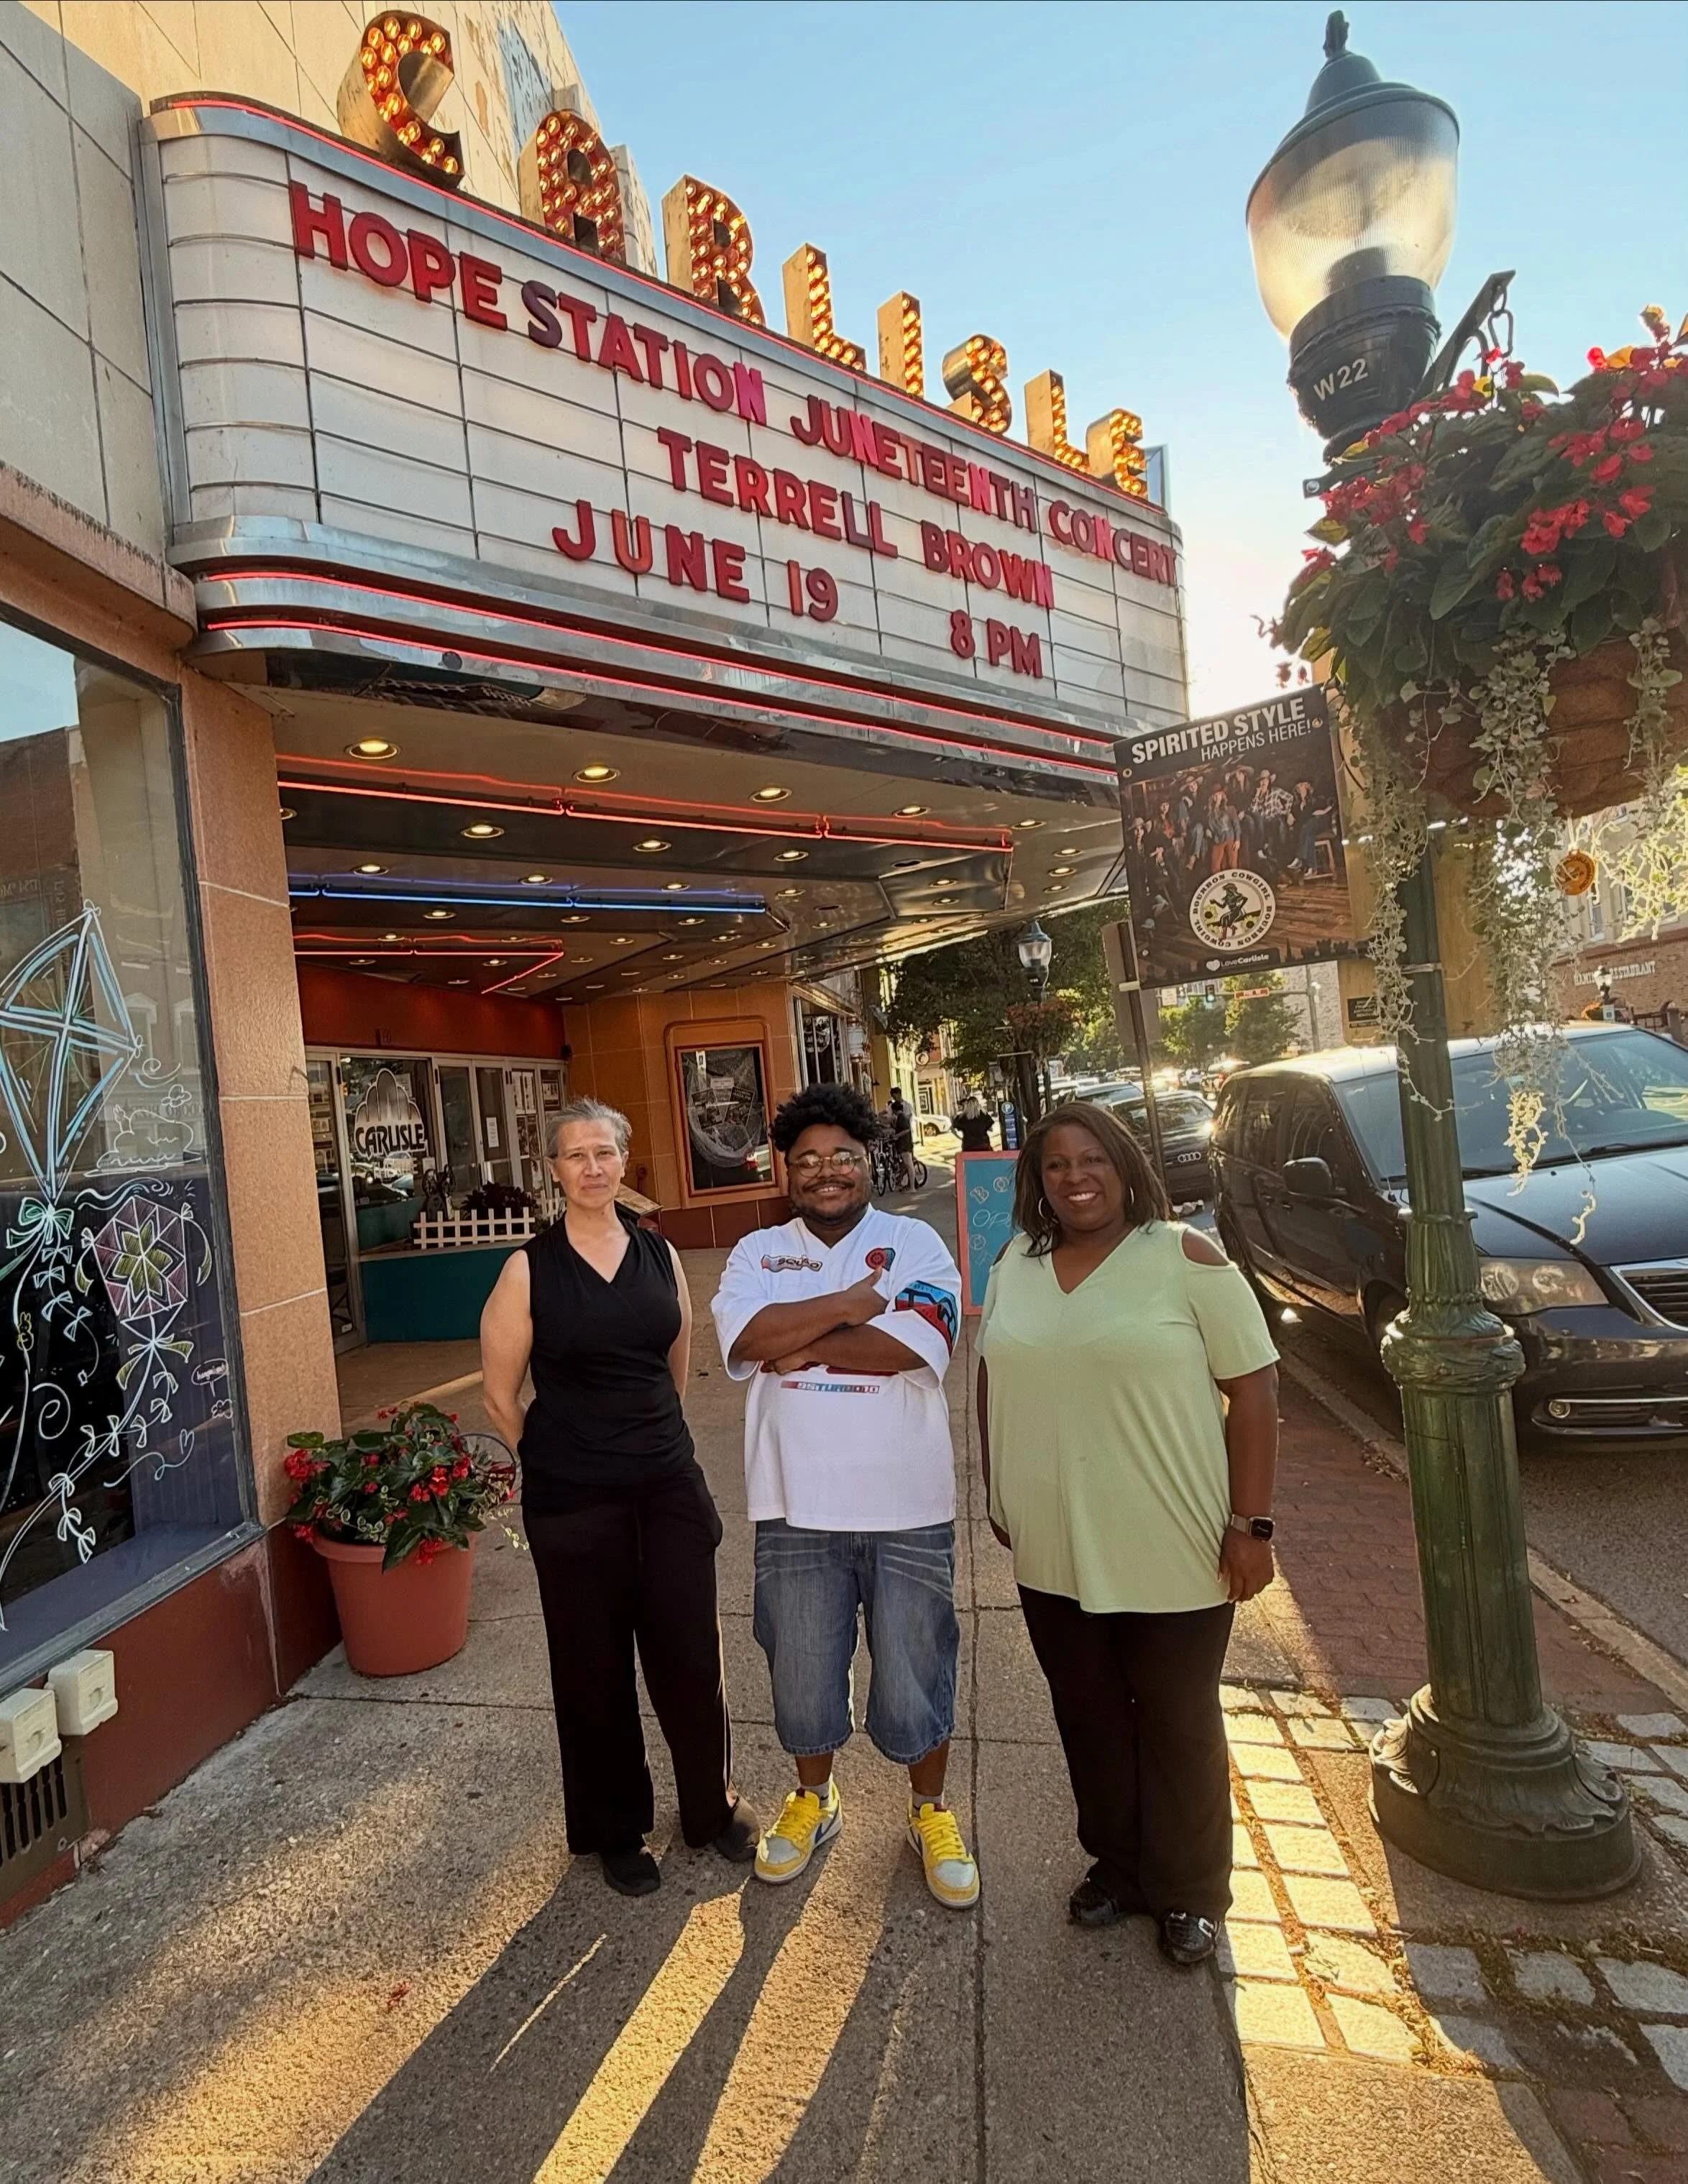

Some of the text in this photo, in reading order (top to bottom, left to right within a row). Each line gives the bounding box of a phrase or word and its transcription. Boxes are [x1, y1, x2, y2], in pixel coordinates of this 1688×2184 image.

[337, 10, 1148, 498] CARLISLE
[290, 180, 1178, 587] HOPE STATION JUNETEENTH CONCERT
[1313, 358, 1368, 401] W22
[658, 426, 1055, 610] TERRELL BROWN
[552, 500, 1043, 679] JUNE 19 8 PM
[1132, 697, 1306, 764] SPIRITED STYLE
[1201, 720, 1311, 761] HAPPENS HERE!
[1193, 872, 1271, 914] BOURBON COWGIRL
[1237, 905, 1272, 946] BOURBON
[1609, 960, 1656, 980] RESTAURANT
